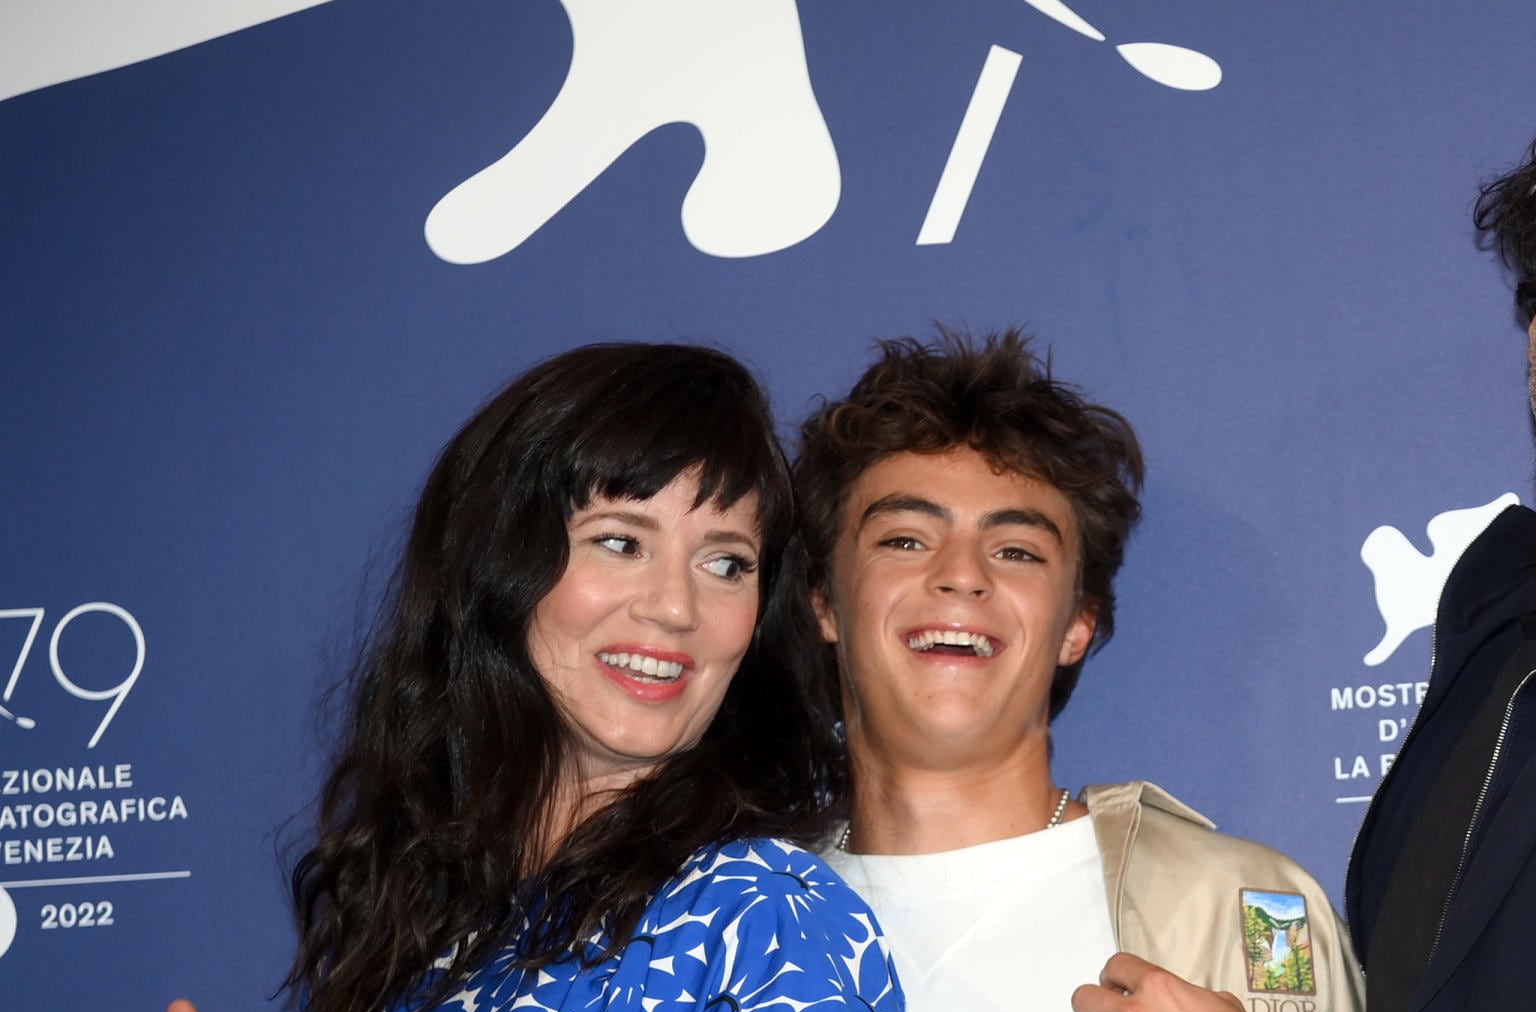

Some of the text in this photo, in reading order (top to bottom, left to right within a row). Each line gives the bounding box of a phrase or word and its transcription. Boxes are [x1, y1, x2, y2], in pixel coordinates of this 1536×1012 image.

[0, 764, 133, 796] ZIONALE
[1334, 755, 1370, 780] LA
[0, 835, 114, 864] ENEZIA
[41, 901, 114, 929] 2022
